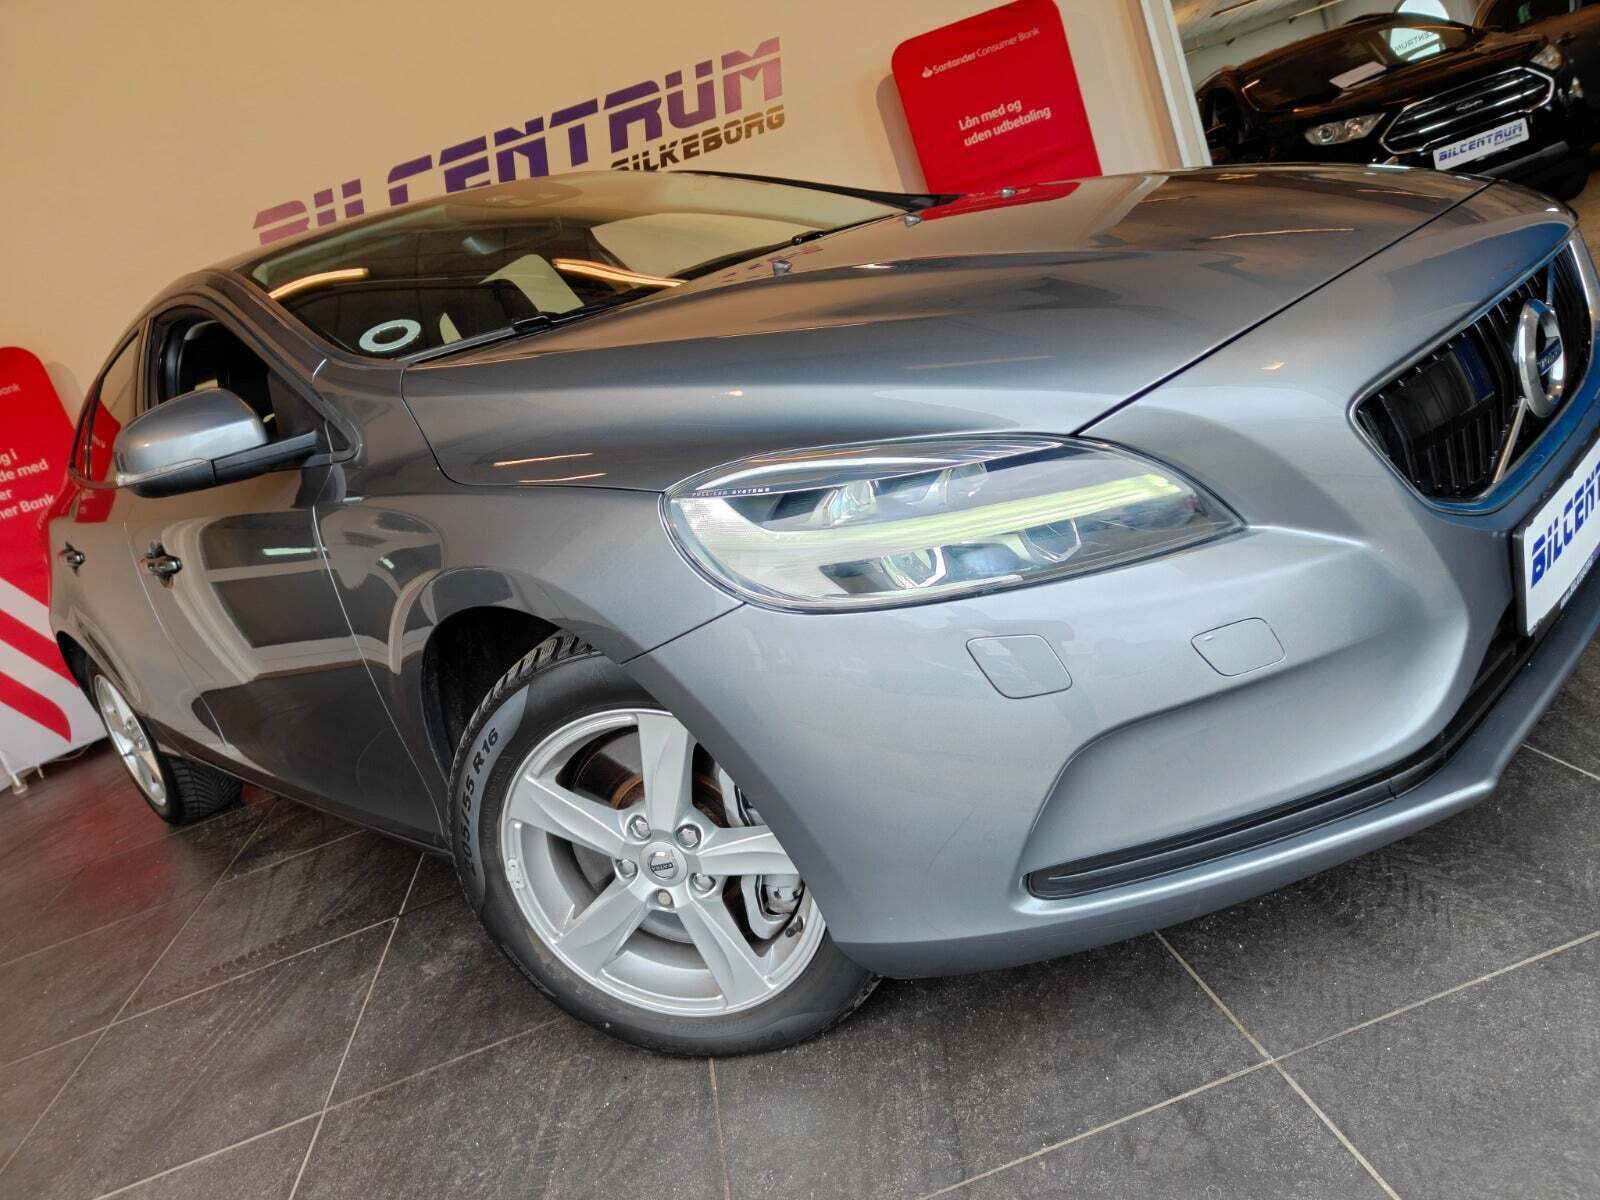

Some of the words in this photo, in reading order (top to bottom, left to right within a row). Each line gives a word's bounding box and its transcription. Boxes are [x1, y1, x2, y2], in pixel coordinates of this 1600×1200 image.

[933, 51, 976, 75] Santander
[976, 36, 1018, 56] Consumer
[1018, 26, 1040, 41] Bank
[958, 115, 980, 131] Lån
[980, 103, 1006, 122] med
[1007, 100, 1022, 113] og
[964, 132, 992, 147] uden
[993, 107, 1052, 136] udbetaling
[1439, 122, 1523, 162] BILCENTRUM
[0, 383, 21, 395] ank
[0, 453, 11, 466] g
[17, 458, 49, 477] med
[19, 493, 54, 513] Bank
